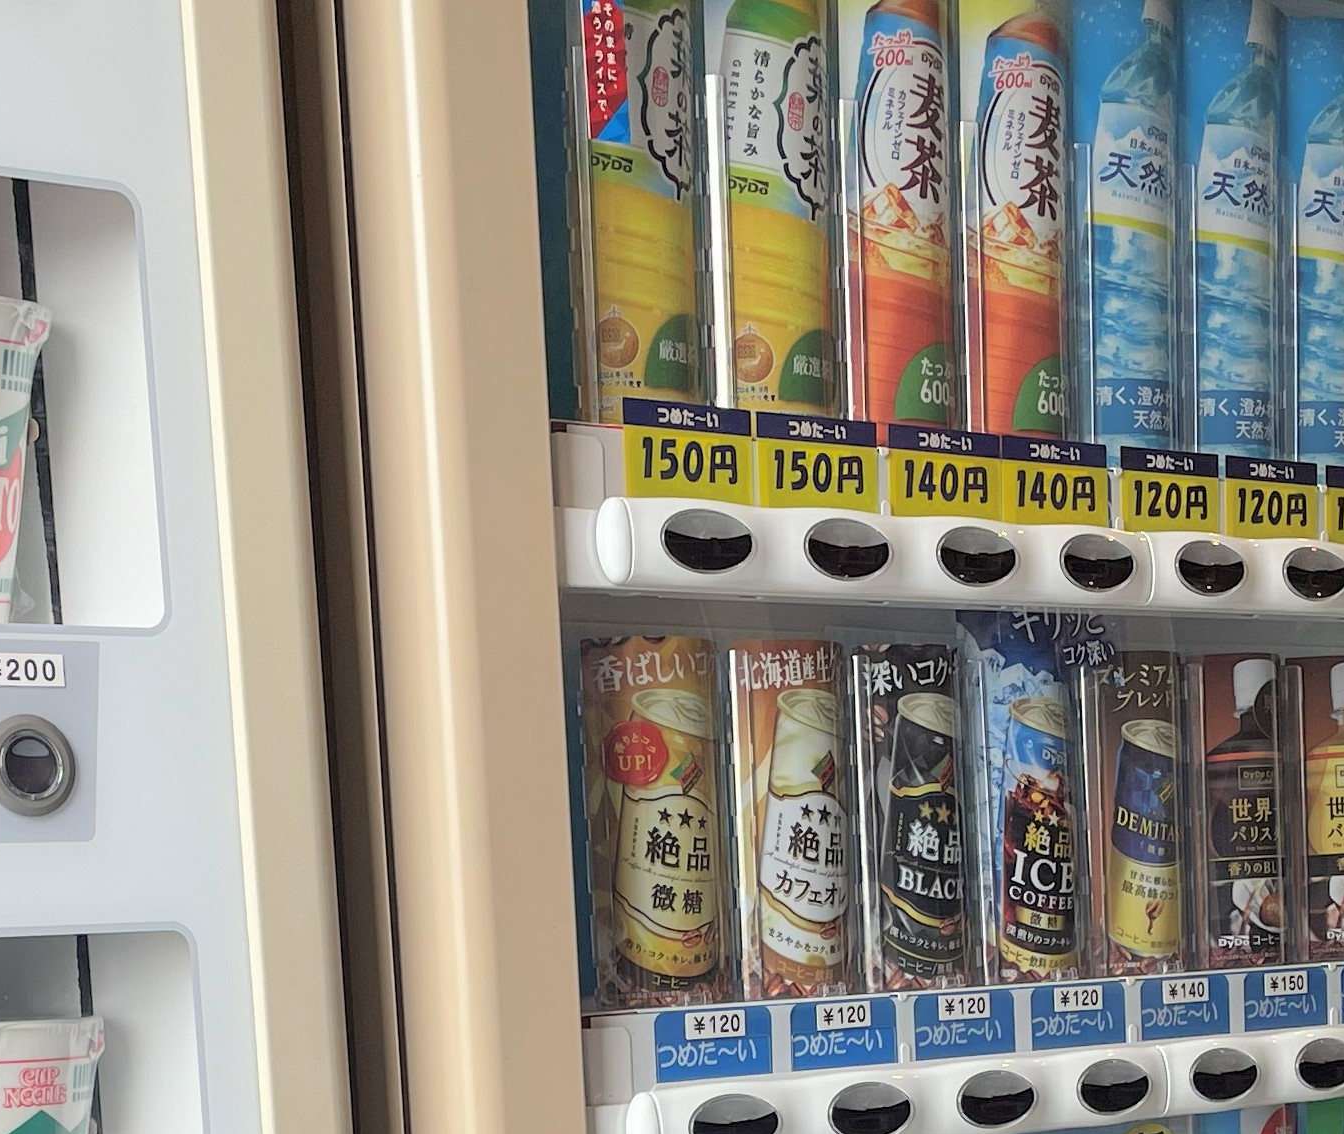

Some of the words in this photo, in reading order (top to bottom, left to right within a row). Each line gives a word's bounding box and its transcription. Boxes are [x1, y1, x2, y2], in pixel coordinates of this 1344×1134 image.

[873, 30, 912, 46] たっぷり
[875, 50, 913, 67] 600ml
[994, 54, 1031, 69] たっぷり
[995, 72, 1032, 89] 600ml
[743, 48, 770, 157] 清らかな旨み
[883, 87, 896, 131] ミネラル
[891, 90, 907, 161] カフェインゼロ
[900, 73, 943, 204] 麦茶
[1002, 109, 1015, 151] ミネラル
[1011, 112, 1025, 179] カフェインゼロ
[1019, 95, 1061, 221] 麦茶
[641, 437, 738, 483] 150円
[774, 450, 865, 494] 150円
[904, 459, 988, 503] 140円
[1016, 467, 1095, 512] 140円
[1133, 480, 1208, 520] 120円
[1238, 488, 1307, 527] 120円
[618, 753, 653, 773] UP!
[645, 825, 710, 873] 絶品
[787, 822, 844, 867] 絶品
[651, 884, 704, 916] 微糖
[1218, 934, 1250, 948] DyDo
[651, 975, 689, 989] コーヒー
[1060, 990, 1099, 1006] ¥120
[1167, 982, 1206, 999] ¥140
[1269, 975, 1304, 992] ¥150
[822, 1004, 866, 1024] ¥120
[944, 997, 986, 1015] ¥120
[693, 1014, 741, 1034] ¥120
[18, 1066, 61, 1088] CUP
[3, 1084, 68, 1109] NOODLE
